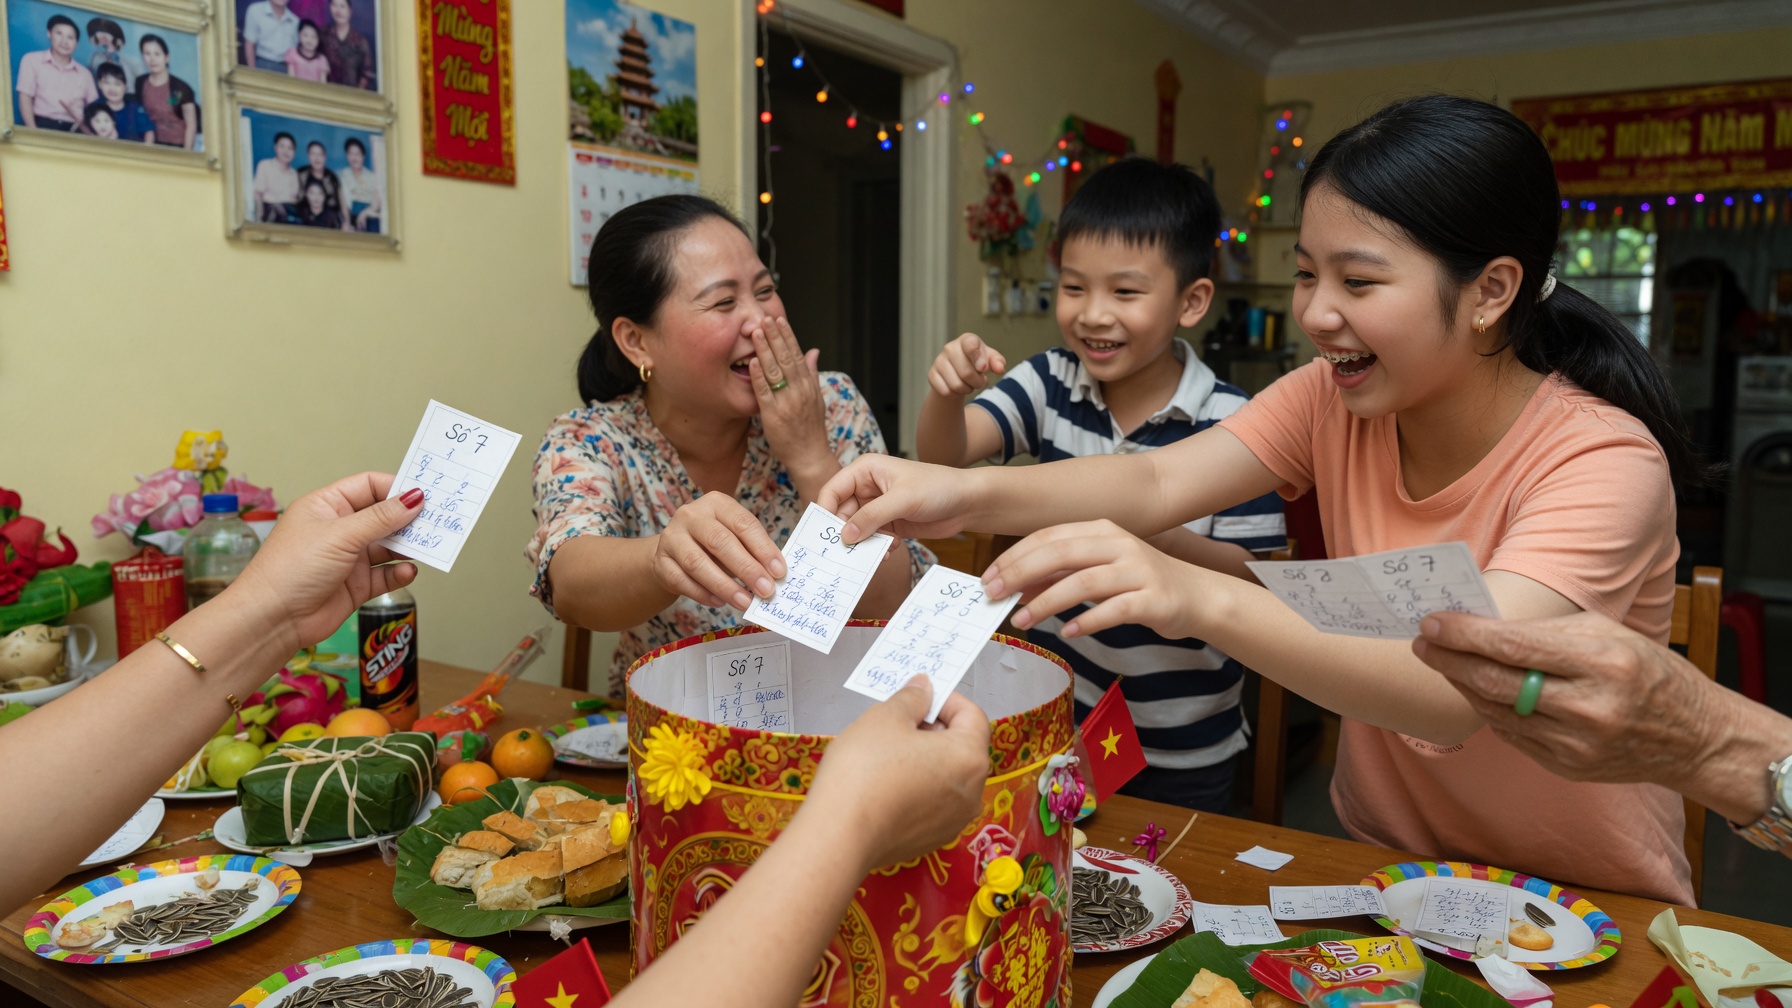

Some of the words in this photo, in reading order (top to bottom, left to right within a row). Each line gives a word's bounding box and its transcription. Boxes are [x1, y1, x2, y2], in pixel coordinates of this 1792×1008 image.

[446, 423, 480, 443] Số
[474, 434, 489, 453] 7
[1419, 555, 1435, 573] 7
[968, 590, 984, 606] 7
[365, 623, 413, 679] STING
[728, 654, 751, 677] Số
[754, 656, 764, 674] 7
